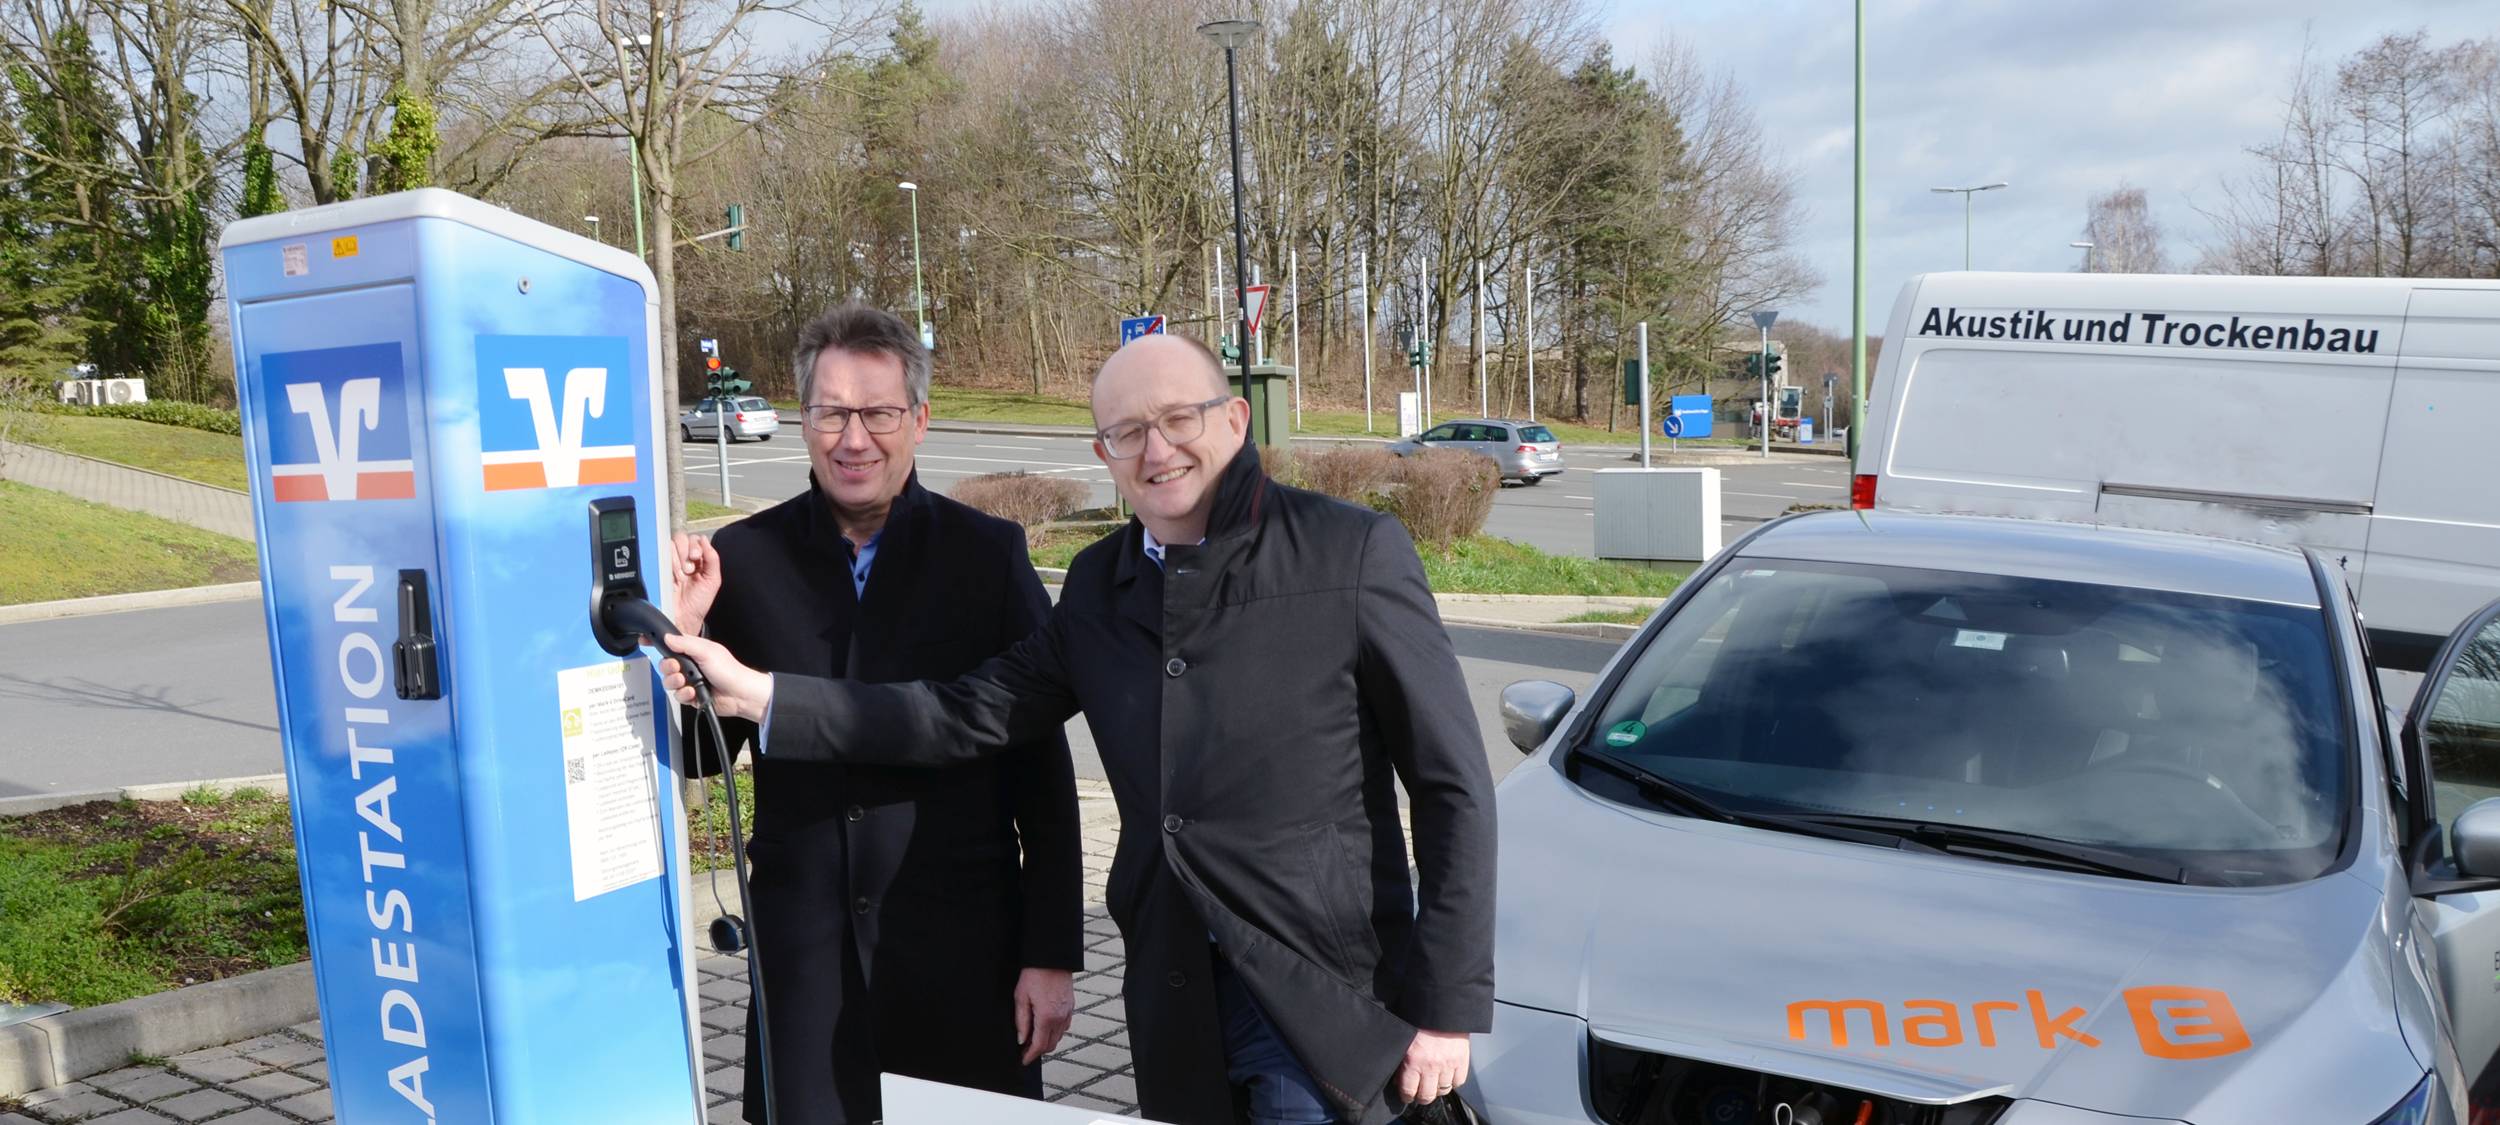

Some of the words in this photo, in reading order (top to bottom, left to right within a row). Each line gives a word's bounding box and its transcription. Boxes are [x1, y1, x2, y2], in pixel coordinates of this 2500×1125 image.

[1919, 307, 2054, 341] Akustik
[2062, 313, 2132, 344] und
[2141, 313, 2379, 353] Trockenbau
[329, 565, 436, 1125] ADESTATION
[1786, 990, 2101, 1049] mark
